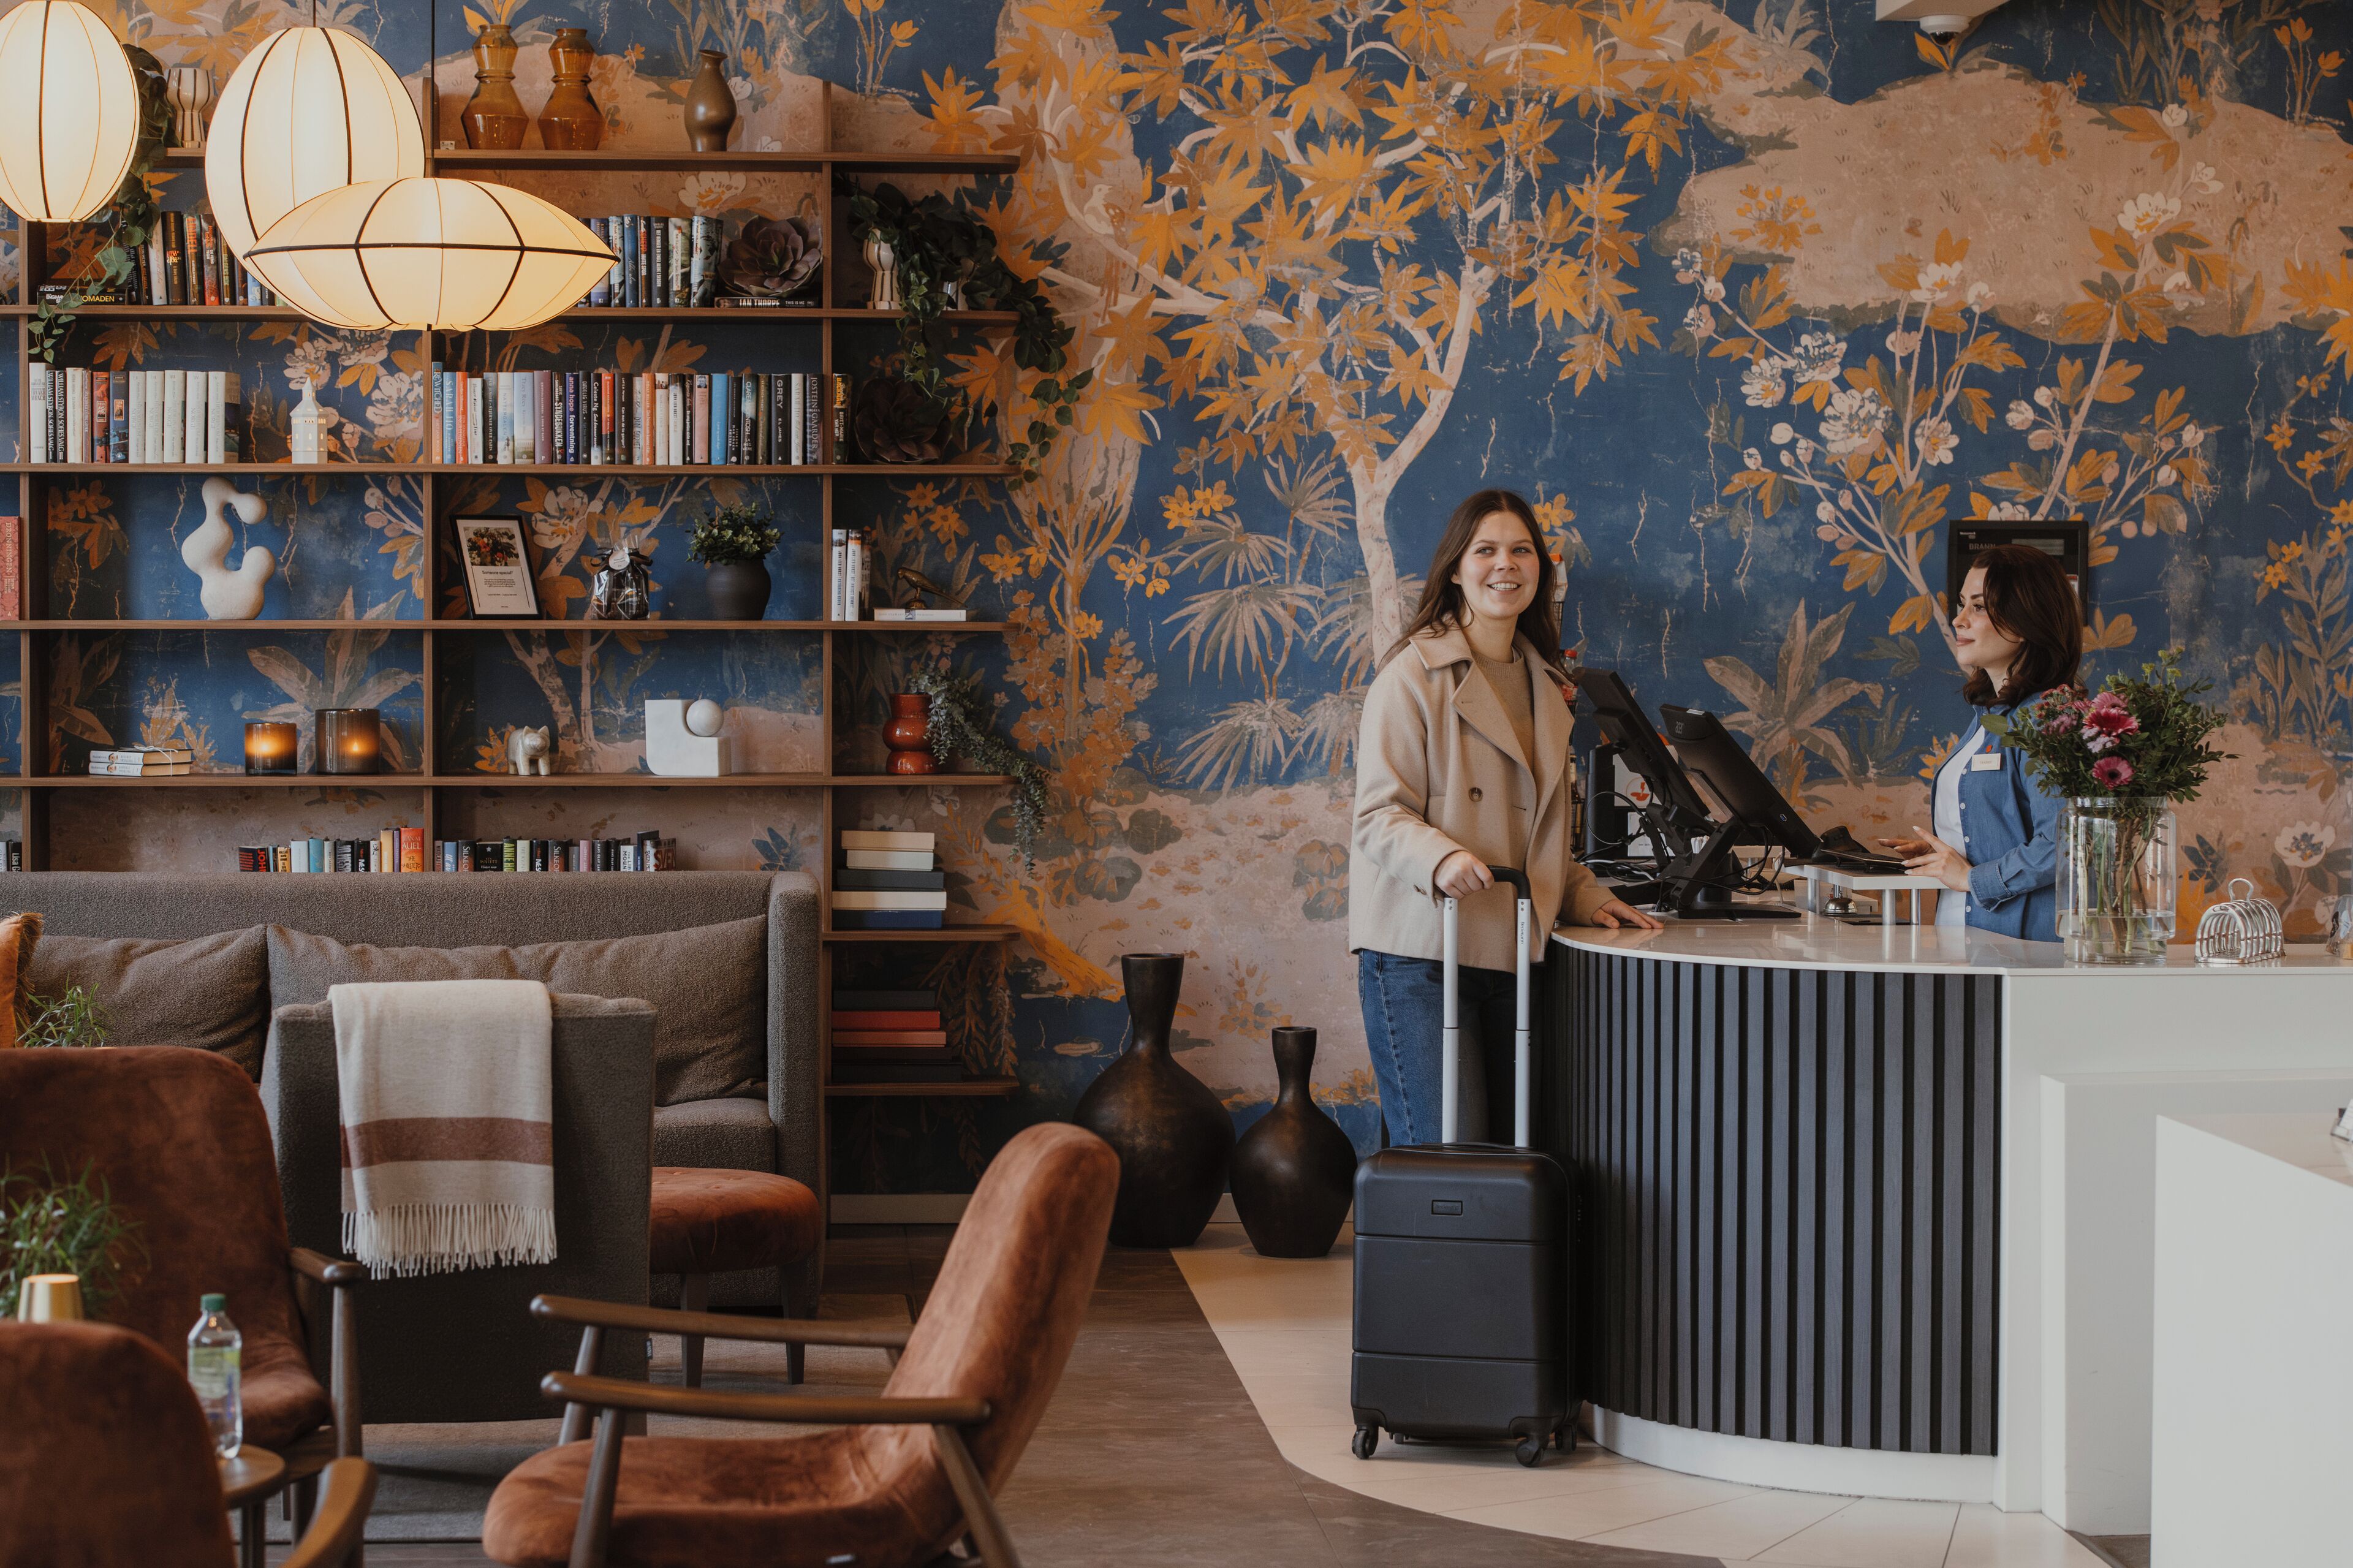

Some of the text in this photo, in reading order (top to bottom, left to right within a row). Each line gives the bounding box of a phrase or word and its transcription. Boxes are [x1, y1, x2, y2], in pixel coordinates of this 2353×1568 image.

[433, 372, 442, 413] REWITCHED
[593, 403, 599, 411] Ng
[555, 402, 563, 447] SYNDEBUKKEN
[504, 843, 515, 861] ANNE
